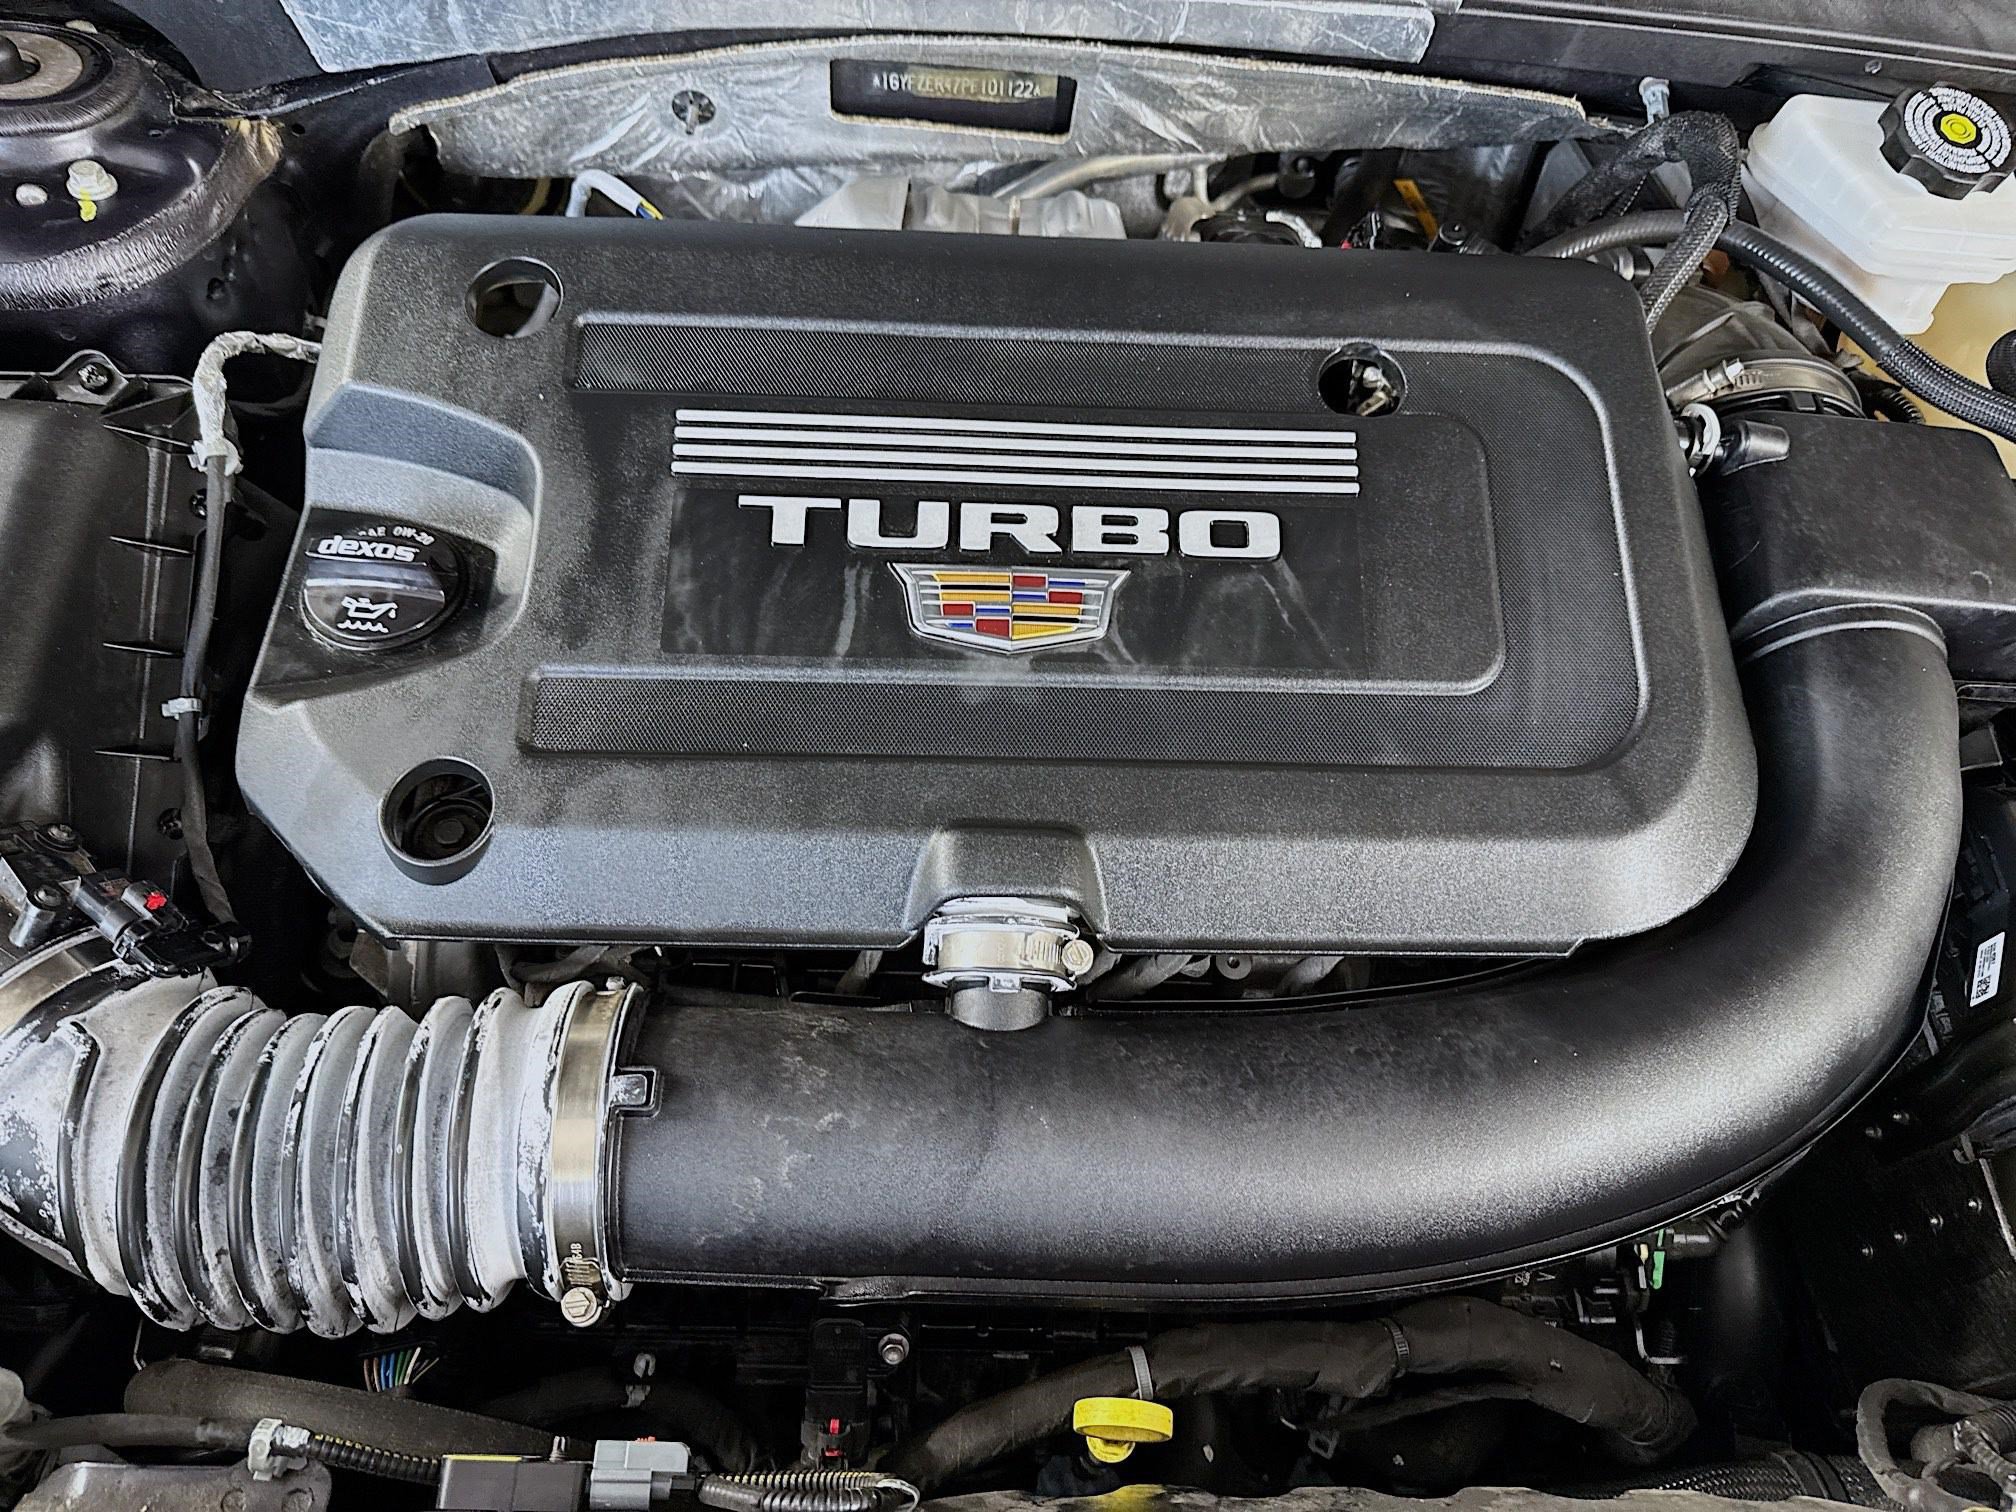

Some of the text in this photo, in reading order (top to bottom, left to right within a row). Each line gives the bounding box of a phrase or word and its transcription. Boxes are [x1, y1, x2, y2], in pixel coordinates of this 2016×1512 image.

[392, 525, 436, 546] 0W-20
[738, 493, 1284, 559] TURBO
[316, 534, 416, 563] dexos
